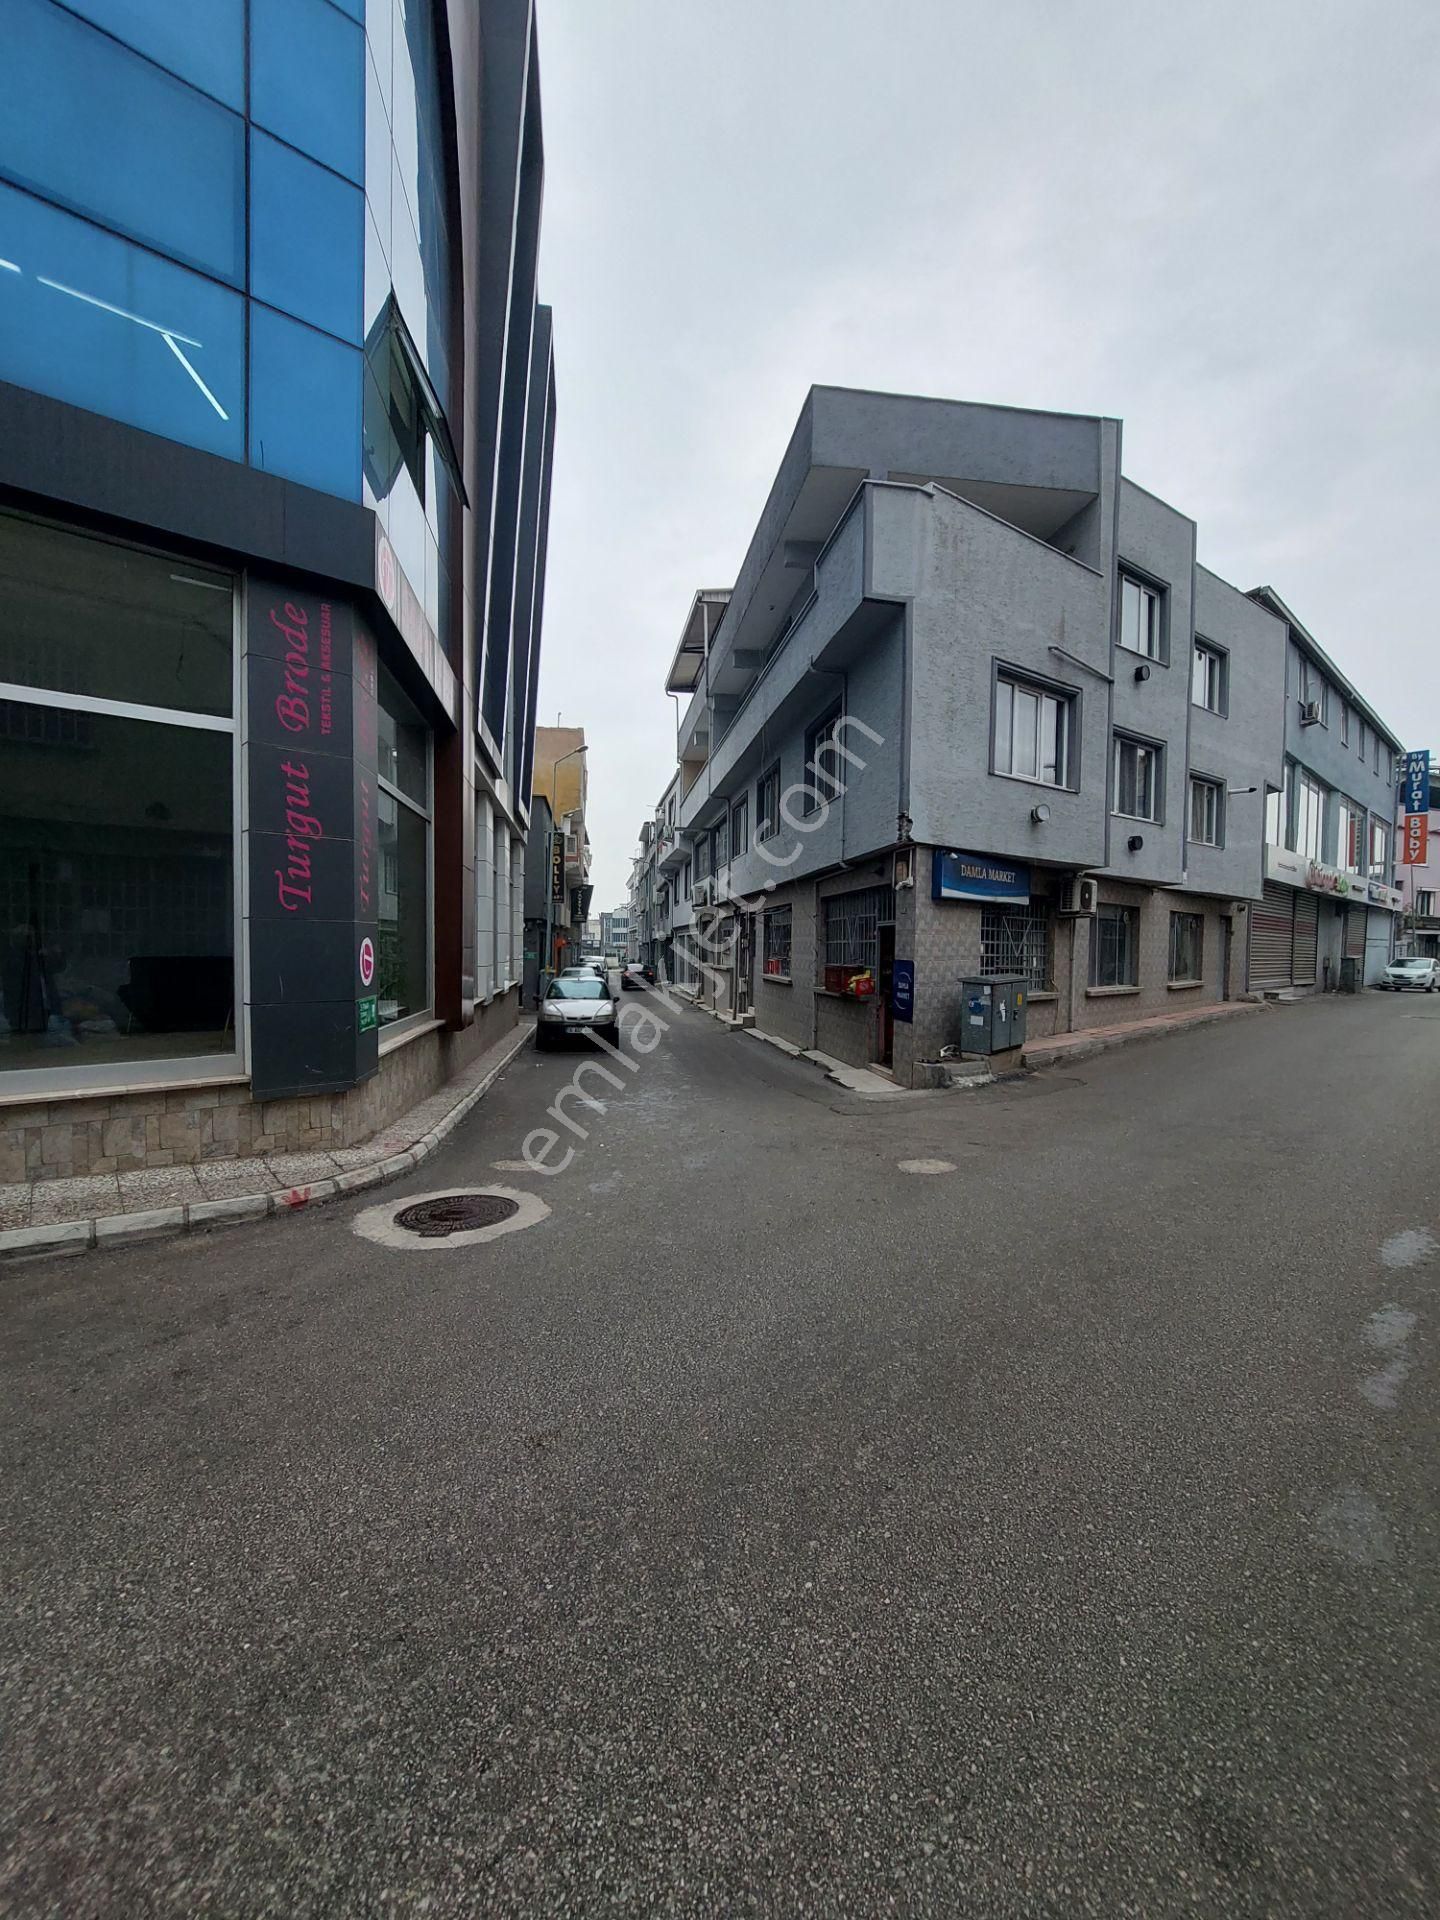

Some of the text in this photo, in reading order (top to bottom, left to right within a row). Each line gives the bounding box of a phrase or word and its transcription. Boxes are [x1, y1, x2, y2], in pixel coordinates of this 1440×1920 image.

[319, 603, 332, 671] AKSESUAR
[269, 602, 322, 911] Turgut Brode
[1409, 761, 1425, 811] Murat
[1409, 817, 1421, 860] Baby
[552, 846, 561, 894] BOLLY
[960, 864, 1016, 884] DAMLA MARKET
